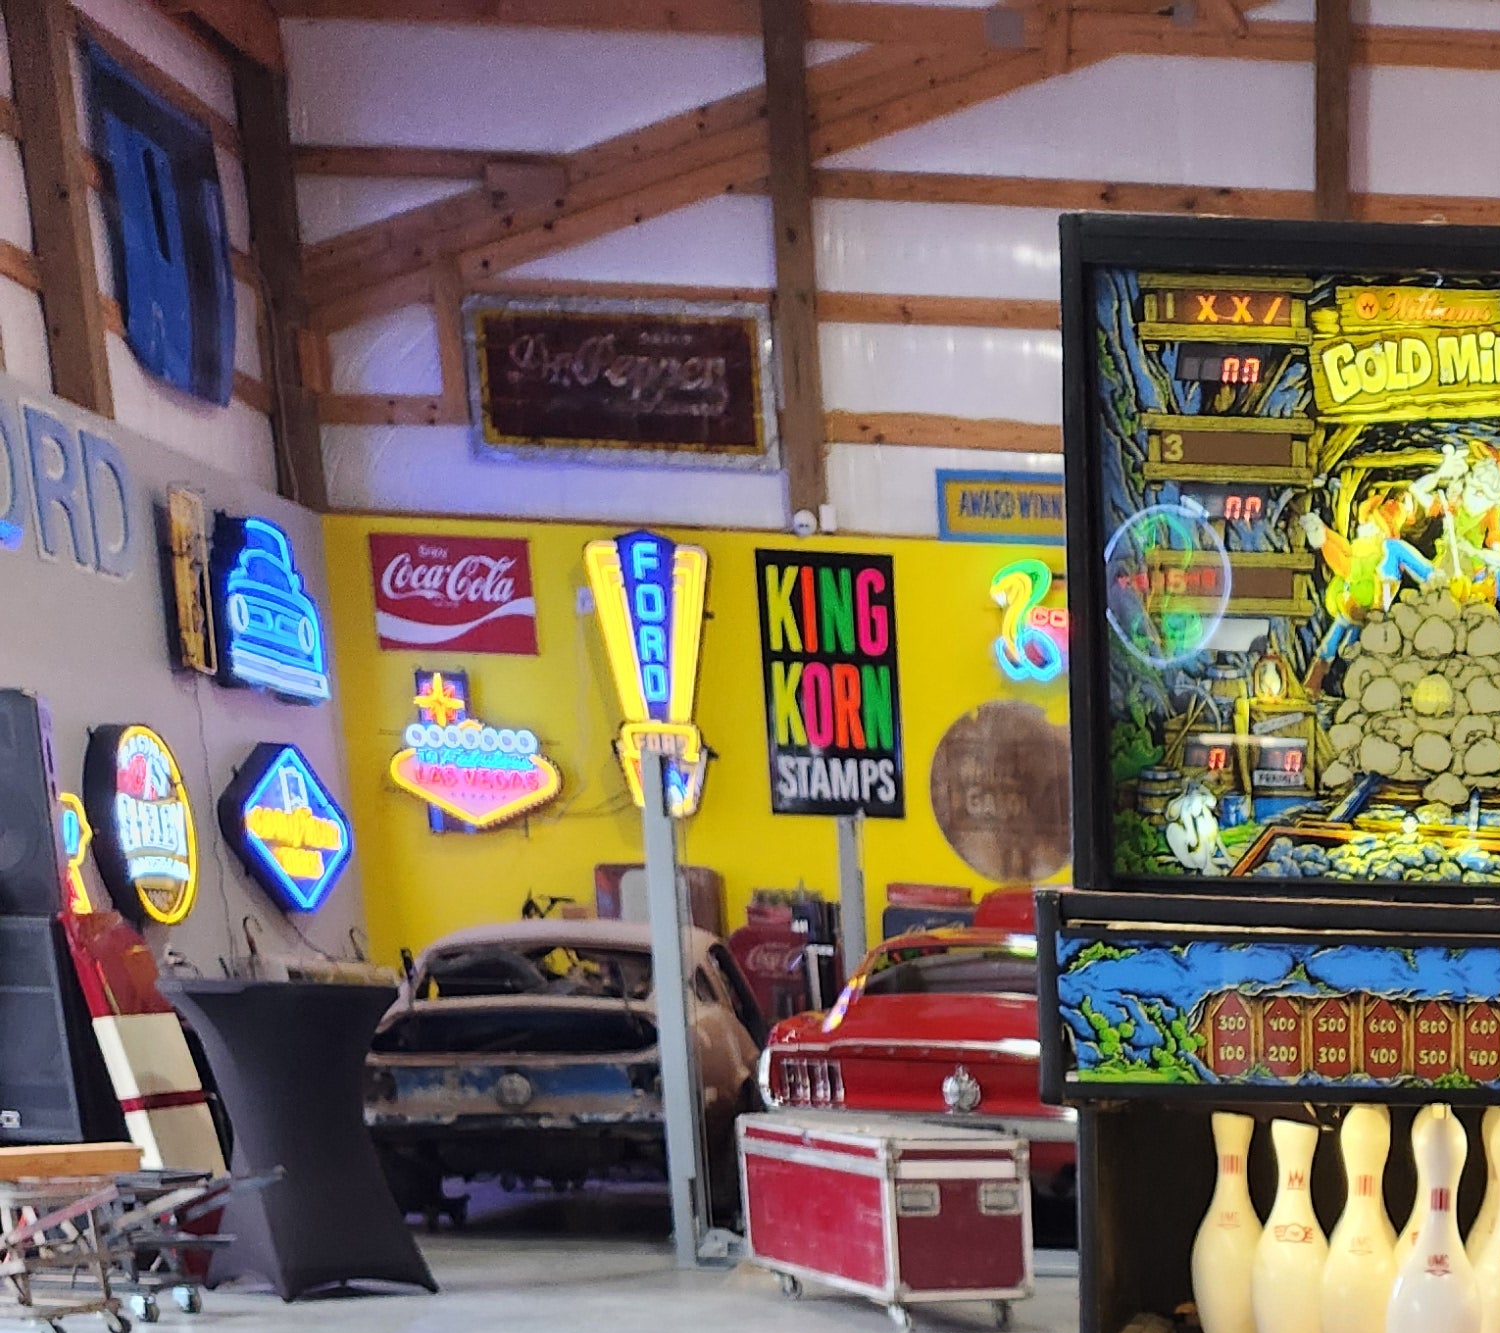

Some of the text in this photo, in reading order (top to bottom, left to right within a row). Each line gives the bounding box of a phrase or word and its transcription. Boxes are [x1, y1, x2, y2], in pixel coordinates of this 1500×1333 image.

[1322, 337, 1433, 403] GOLD
[1164, 434, 1184, 463] 3
[381, 552, 519, 602] Coca-Cola
[631, 540, 668, 703] FORD
[765, 564, 889, 656] KING
[771, 661, 894, 750] KORN
[776, 755, 896, 804] STAMPS
[1218, 1016, 1247, 1032] 300
[1317, 1018, 1347, 1033] 500
[1368, 1019, 1397, 1035] 600
[1418, 1020, 1448, 1035] 800
[1470, 1020, 1498, 1036] 600
[1219, 1046, 1246, 1062] 100
[1268, 1046, 1298, 1063] 200
[1317, 1047, 1347, 1064] 300
[1418, 1049, 1448, 1065] 500
